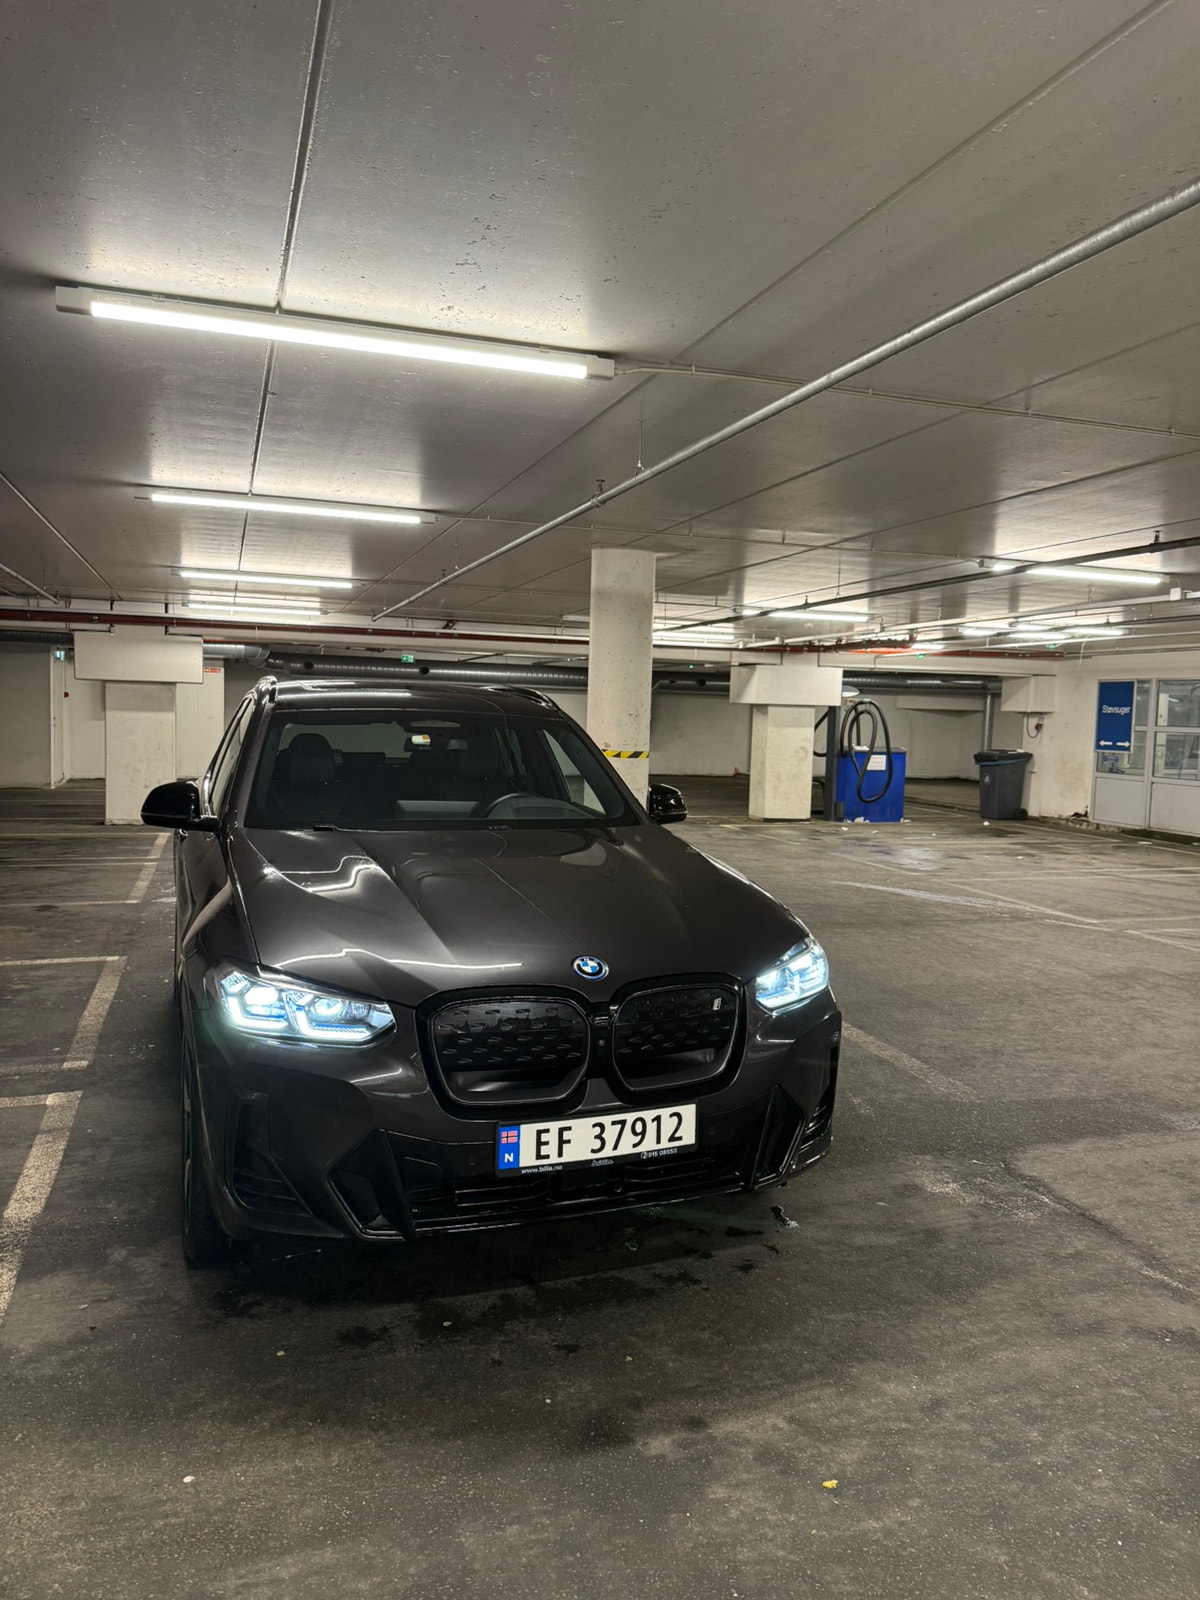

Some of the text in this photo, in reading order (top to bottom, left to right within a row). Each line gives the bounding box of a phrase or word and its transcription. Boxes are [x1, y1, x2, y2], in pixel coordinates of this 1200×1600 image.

[535, 1111, 683, 1161] EF 37912
[504, 1152, 514, 1163] N
